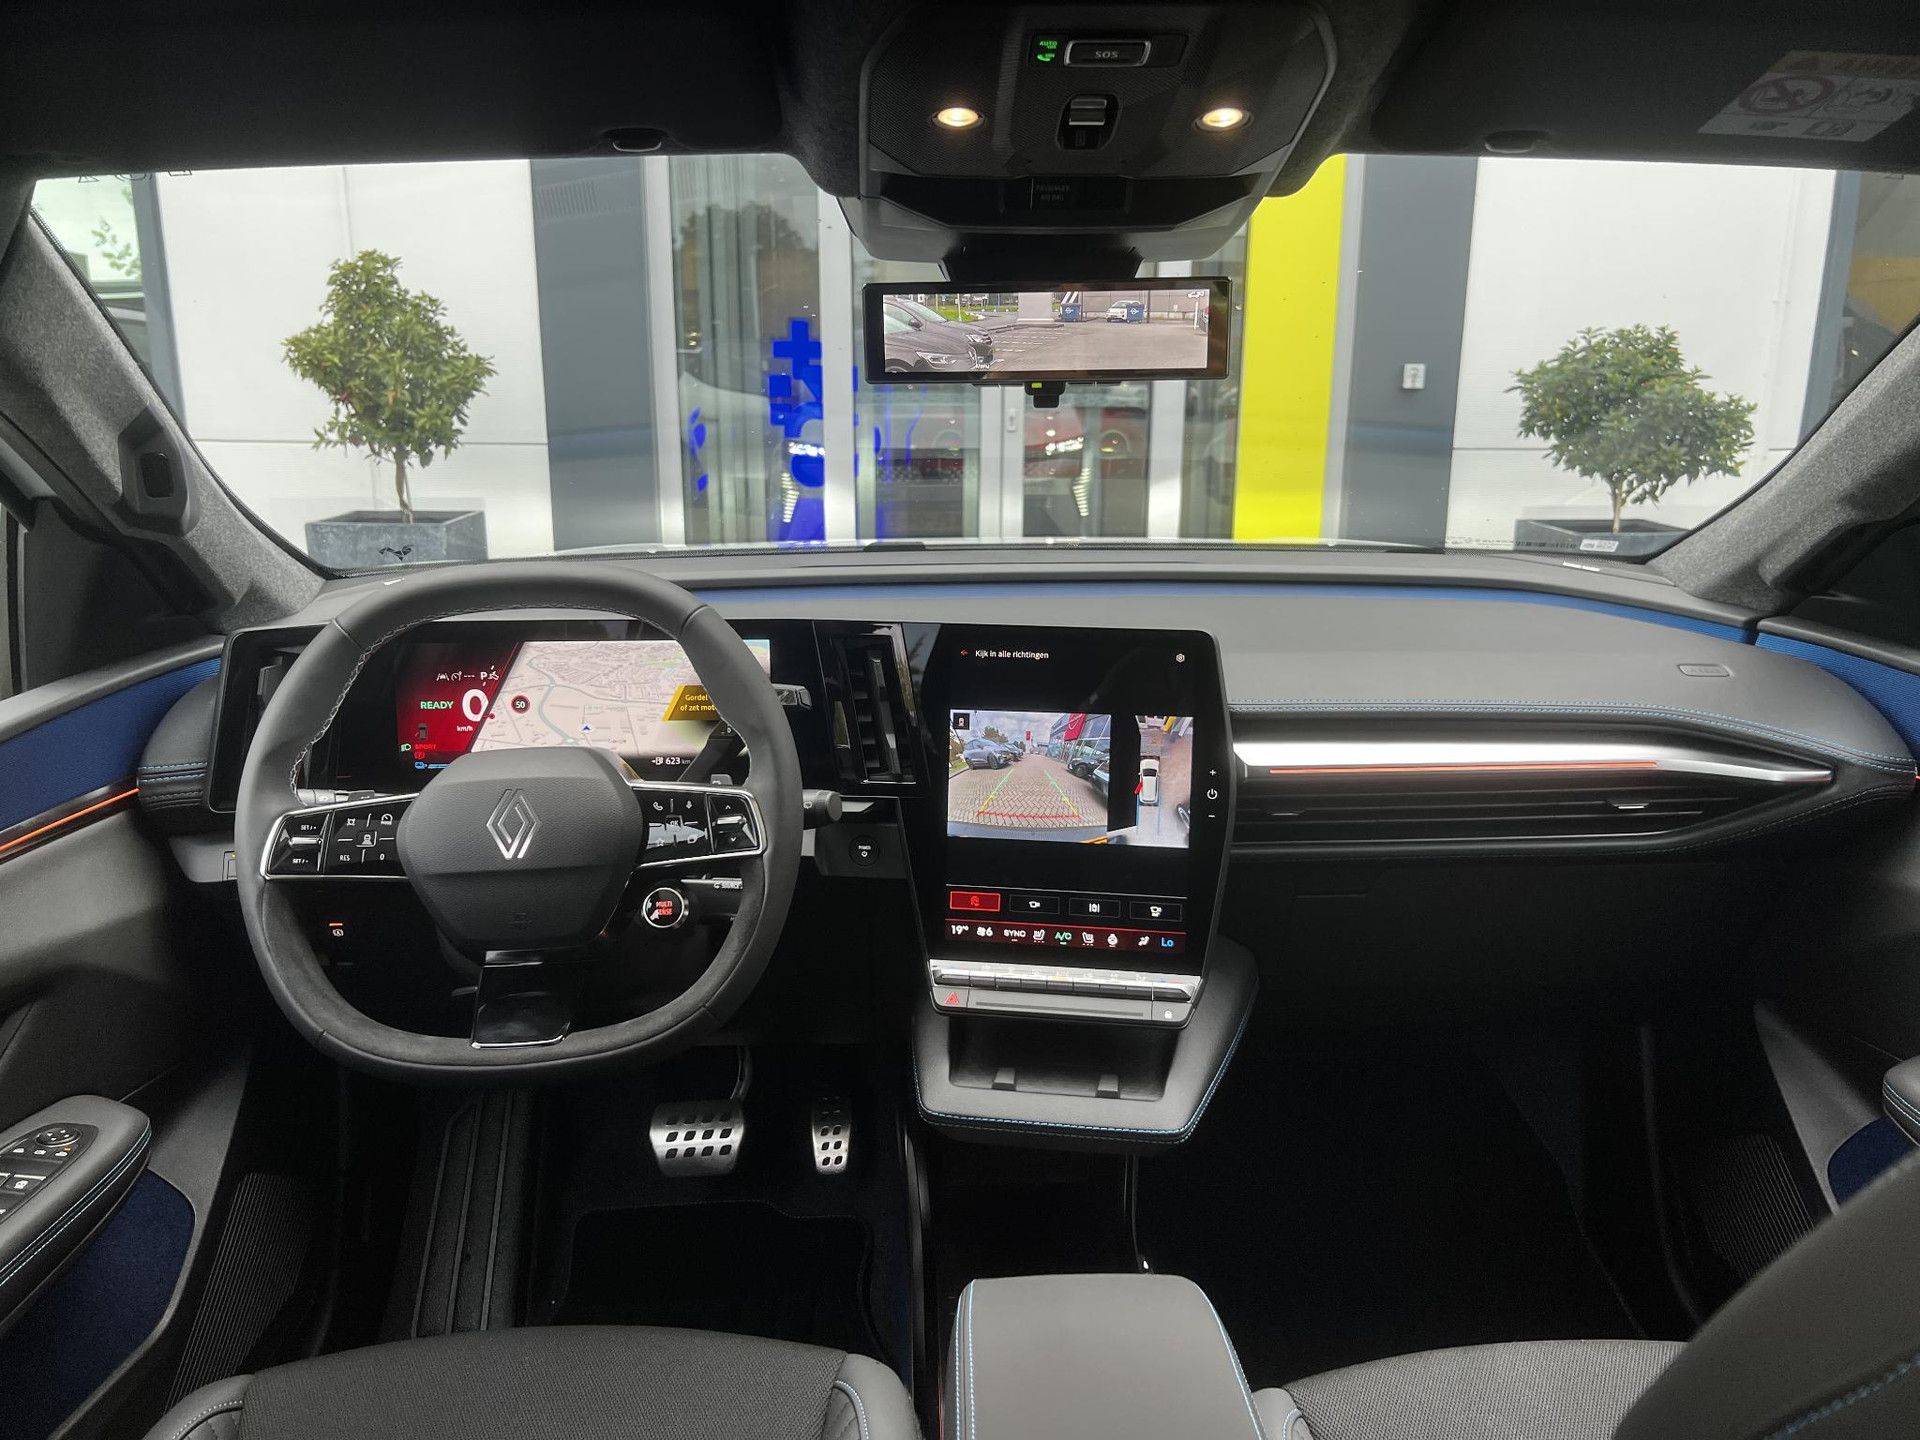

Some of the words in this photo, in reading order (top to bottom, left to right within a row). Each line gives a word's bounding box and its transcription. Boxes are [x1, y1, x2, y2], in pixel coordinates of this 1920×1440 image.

[975, 650, 988, 659] Kijk
[998, 650, 1011, 658] alle
[1012, 650, 1049, 660] richtingen
[480, 671, 488, 680] P
[420, 701, 453, 709] READY
[462, 689, 489, 722] 0
[515, 701, 526, 709] 50
[665, 757, 680, 765] 623
[1161, 936, 1174, 947] Lo
